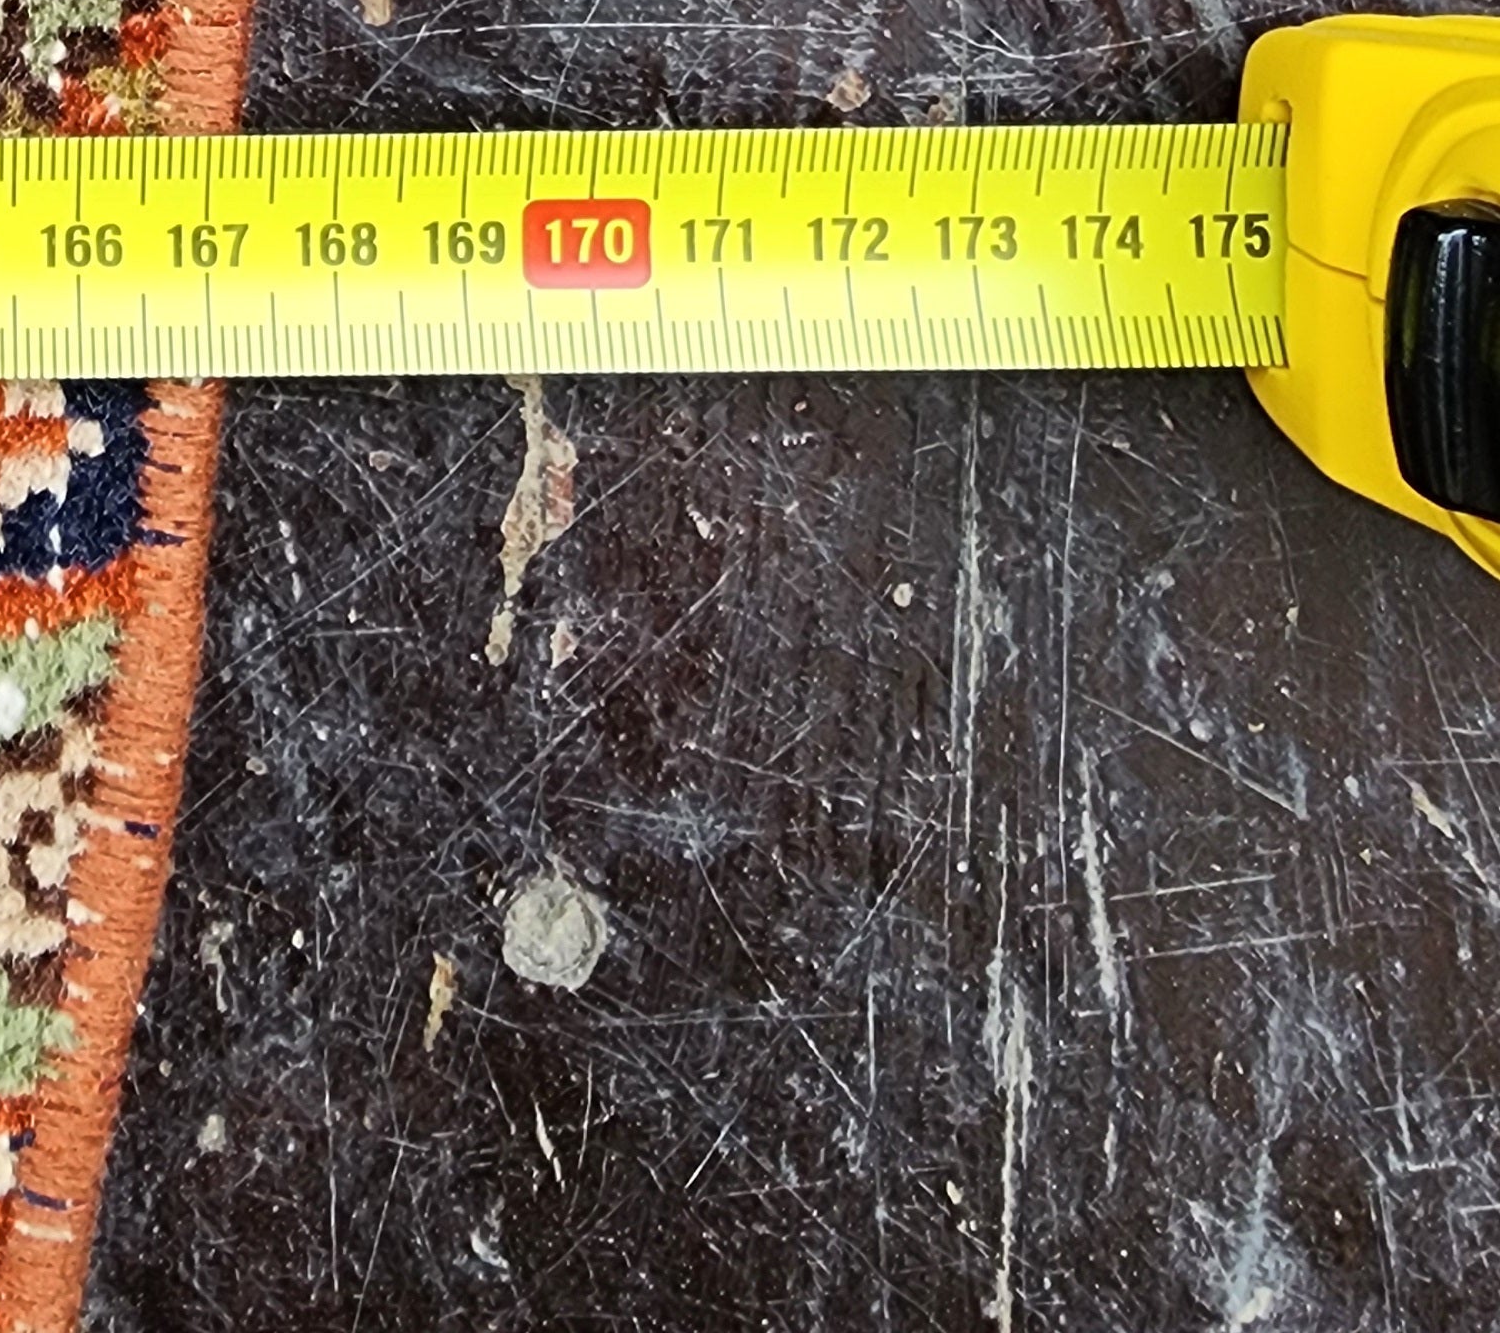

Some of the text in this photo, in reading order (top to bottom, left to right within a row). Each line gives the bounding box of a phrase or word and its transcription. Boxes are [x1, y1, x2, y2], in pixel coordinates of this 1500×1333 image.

[40, 224, 124, 269] 166
[167, 223, 249, 268] 167
[295, 222, 378, 267] 168
[423, 221, 506, 264] 169
[544, 218, 633, 264] 170
[680, 218, 753, 263] 171
[807, 217, 890, 262] 172
[934, 215, 1018, 260] 173
[1062, 215, 1144, 260] 174
[1189, 213, 1271, 259] 175
